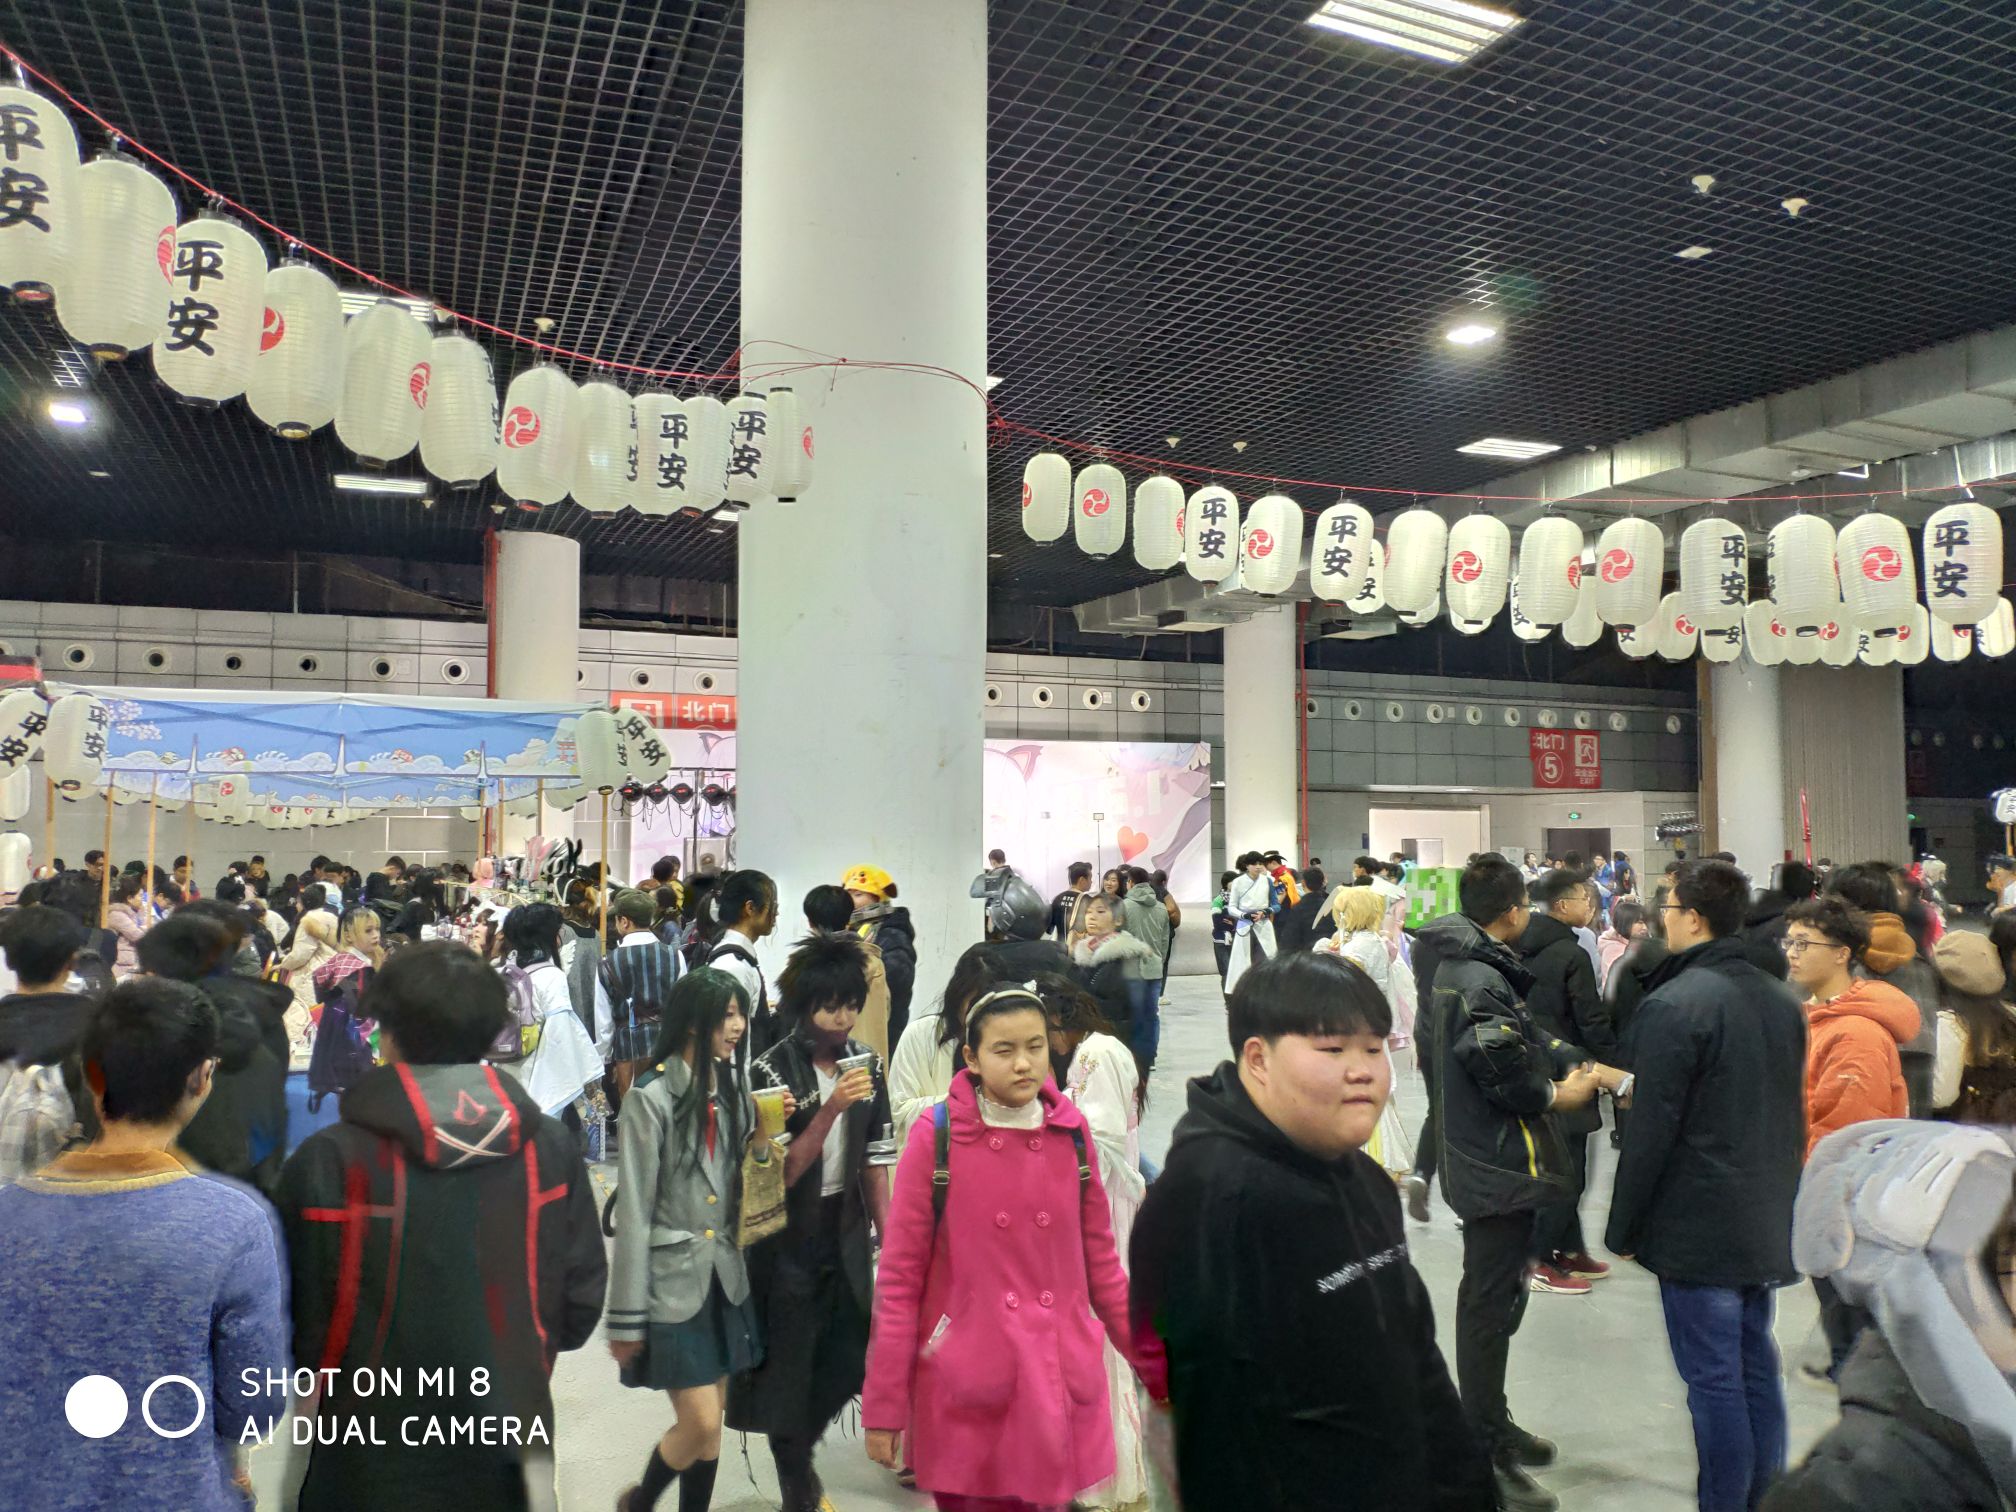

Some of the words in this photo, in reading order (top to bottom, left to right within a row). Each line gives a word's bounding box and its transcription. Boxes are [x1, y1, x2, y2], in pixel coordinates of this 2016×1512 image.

[165, 240, 224, 356] 平安
[657, 413, 688, 491] 平安
[730, 411, 767, 479] 平安
[1199, 498, 1227, 559] 平安
[1322, 515, 1357, 577] 平安
[1933, 520, 1970, 598] 平安
[1720, 534, 1746, 606] 平安
[0, 710, 47, 767] 平安
[82, 705, 108, 765] 平安
[626, 716, 666, 766] 平安
[682, 701, 730, 722] 北门
[1532, 732, 1565, 750] 北门
[1544, 756, 1558, 779] 5
